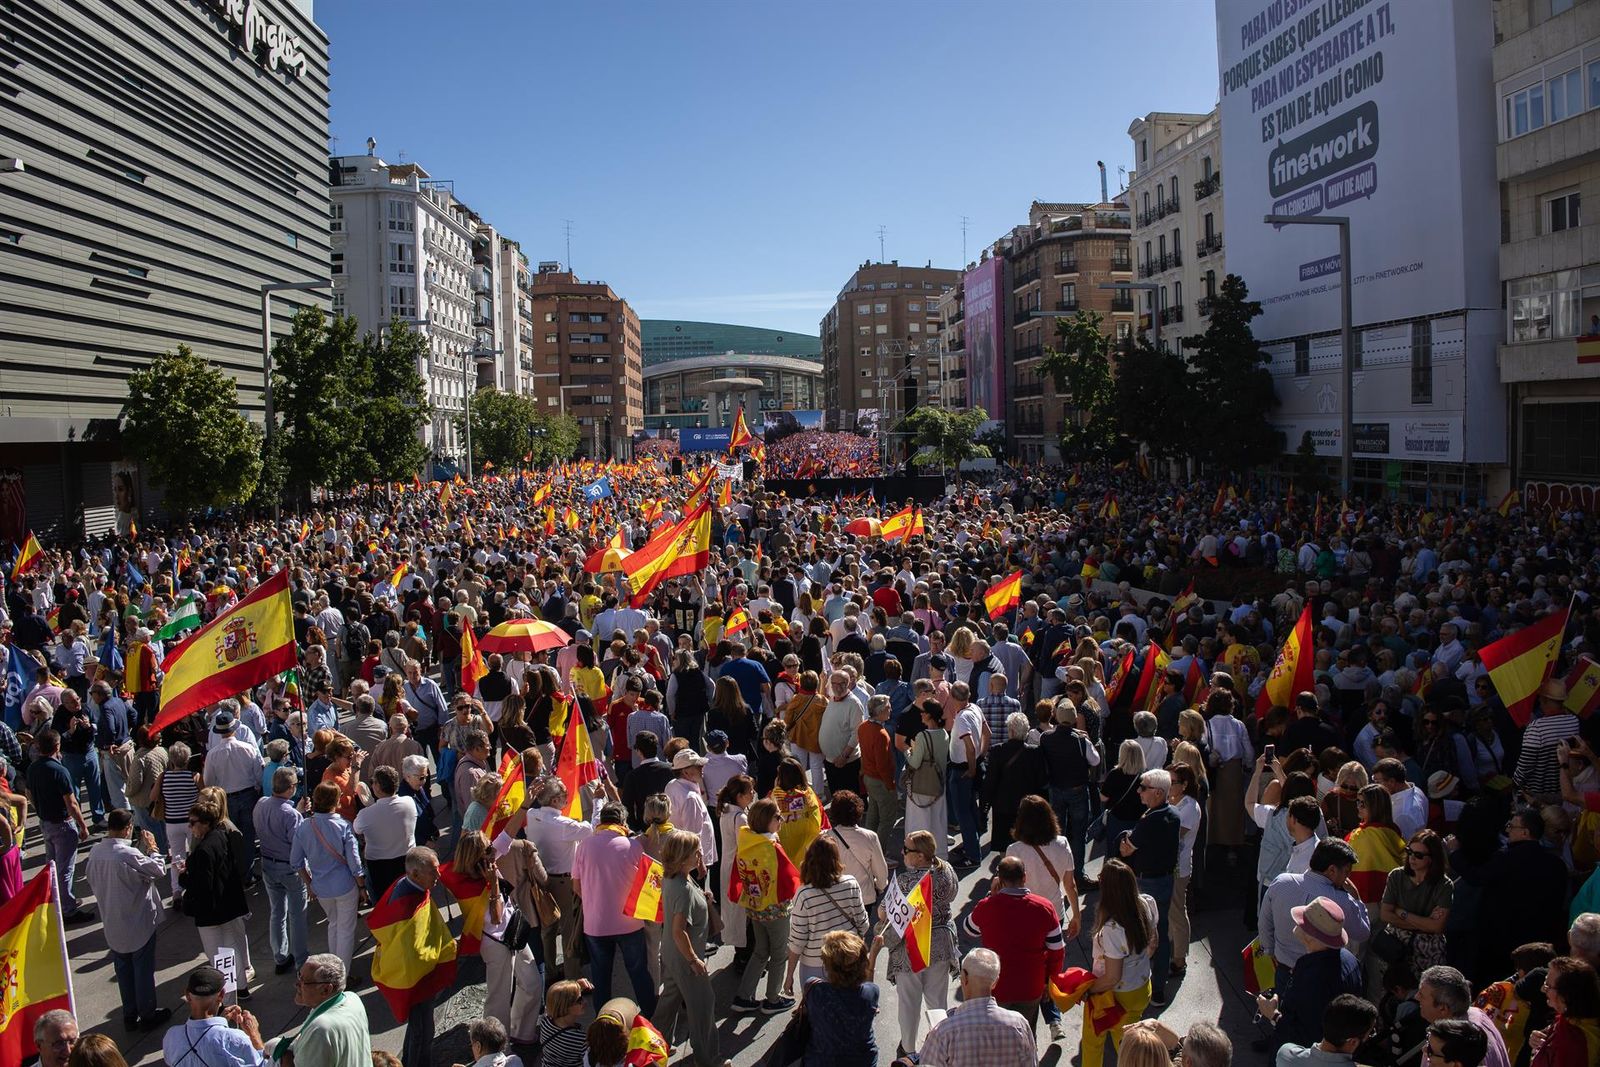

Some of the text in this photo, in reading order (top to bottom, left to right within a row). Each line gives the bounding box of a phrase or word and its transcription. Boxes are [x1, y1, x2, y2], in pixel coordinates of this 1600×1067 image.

[1223, 50, 1262, 96] PORQUE
[1262, 25, 1295, 71] SABES
[1297, 8, 1321, 52] QUE
[1241, 11, 1267, 51] PARA
[1268, 0, 1283, 32] NO
[1252, 2, 1395, 114] PARA NO ESPERARTE A TI,
[1262, 51, 1384, 143] ES TAN DE AQUÍ COMO
[1273, 116, 1373, 186] finetwork
[1328, 180, 1345, 202] MUY
[1345, 177, 1354, 196] DE
[1301, 265, 1319, 278] FIBRA
[1324, 258, 1341, 272] MÓVI
